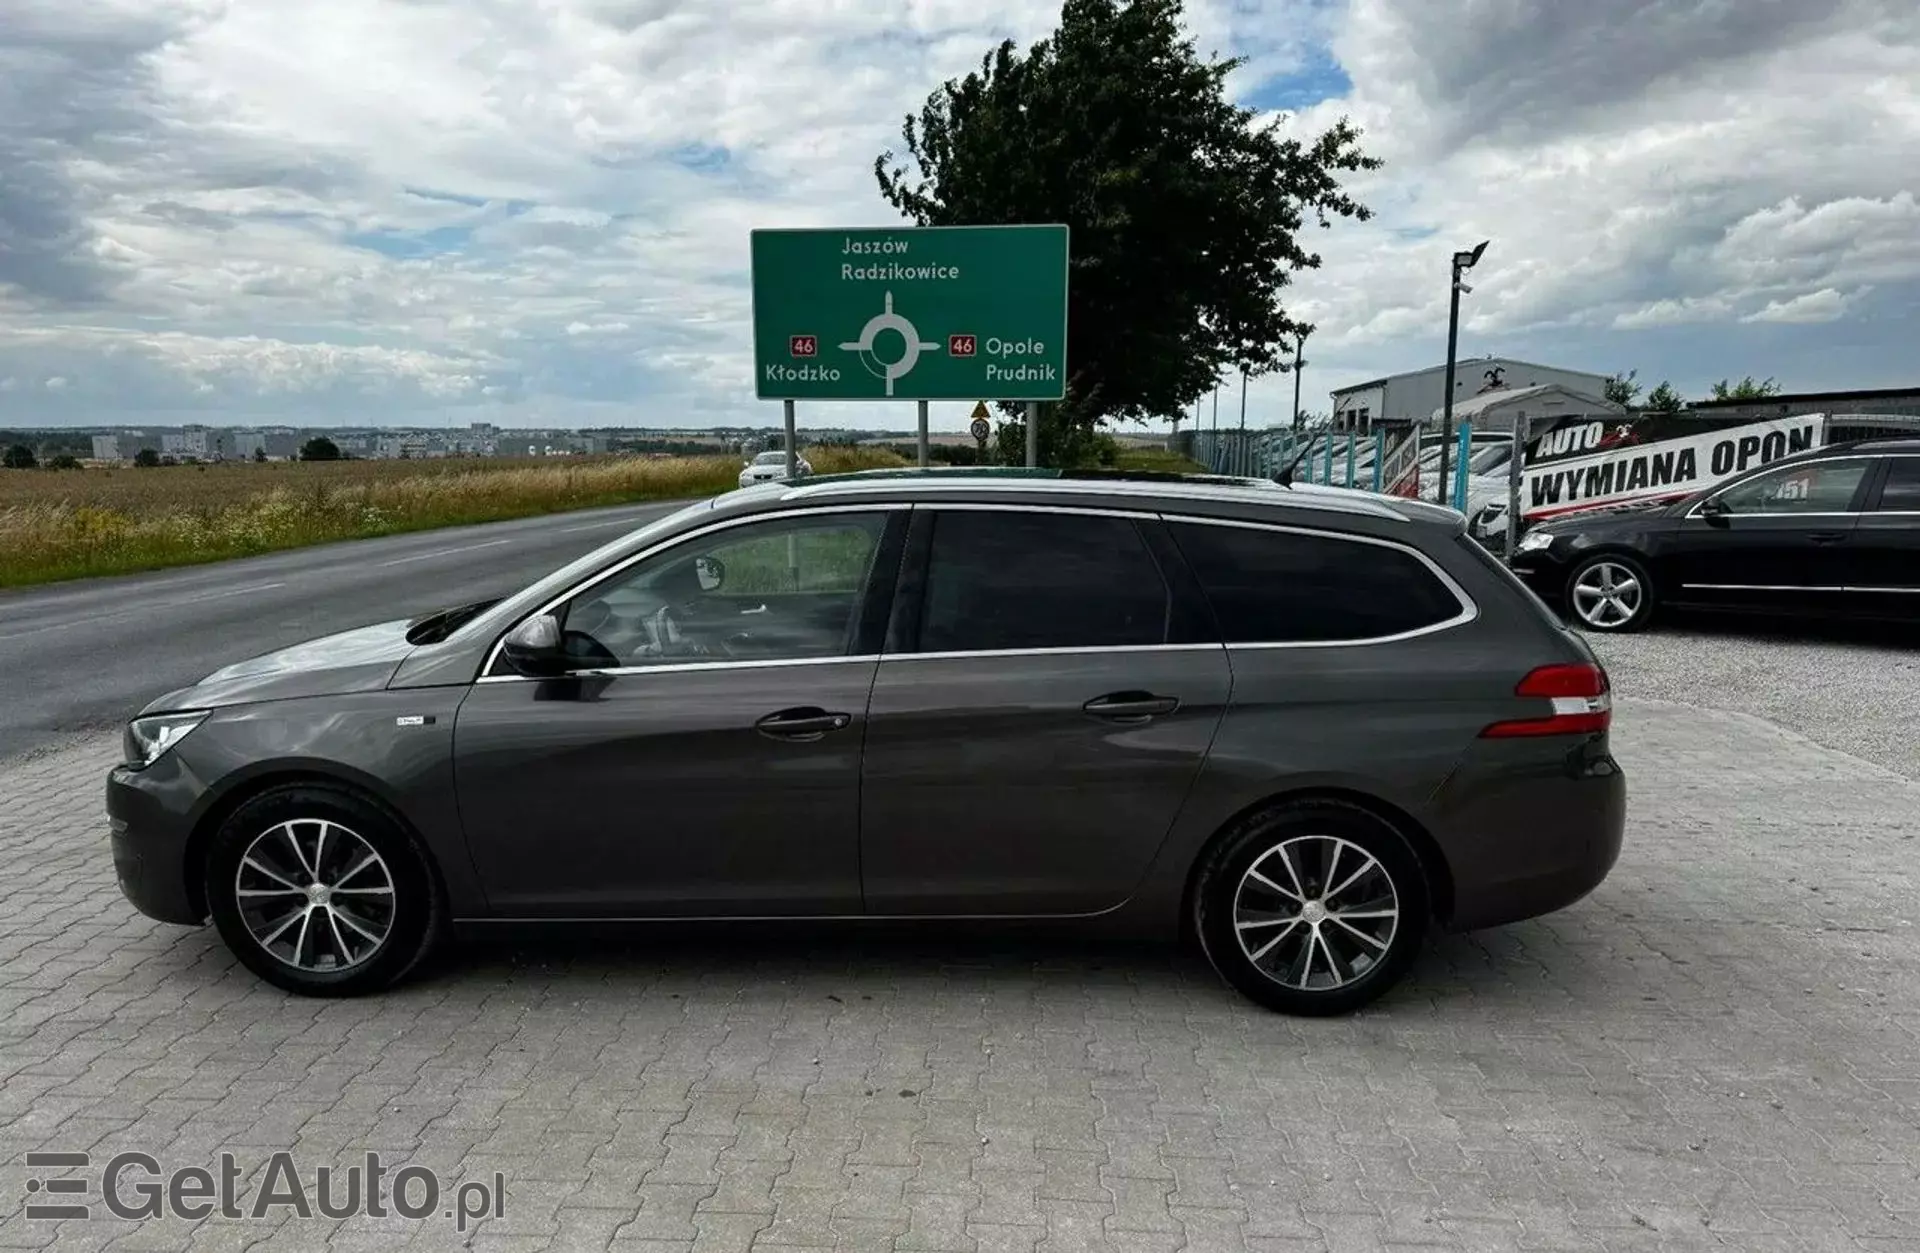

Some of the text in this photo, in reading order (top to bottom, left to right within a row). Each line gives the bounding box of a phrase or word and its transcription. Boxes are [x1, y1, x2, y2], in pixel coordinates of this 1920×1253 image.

[842, 237, 909, 254] Jaszów
[842, 262, 960, 280] Radzikowice
[794, 338, 813, 353] 46
[953, 338, 973, 353] 46
[986, 337, 1044, 358] Opole
[765, 364, 841, 381] Kłodzko
[986, 364, 1056, 381] Prudnik
[1535, 422, 1604, 458] AUTO
[1531, 425, 1813, 507] WYMIANA OPON
